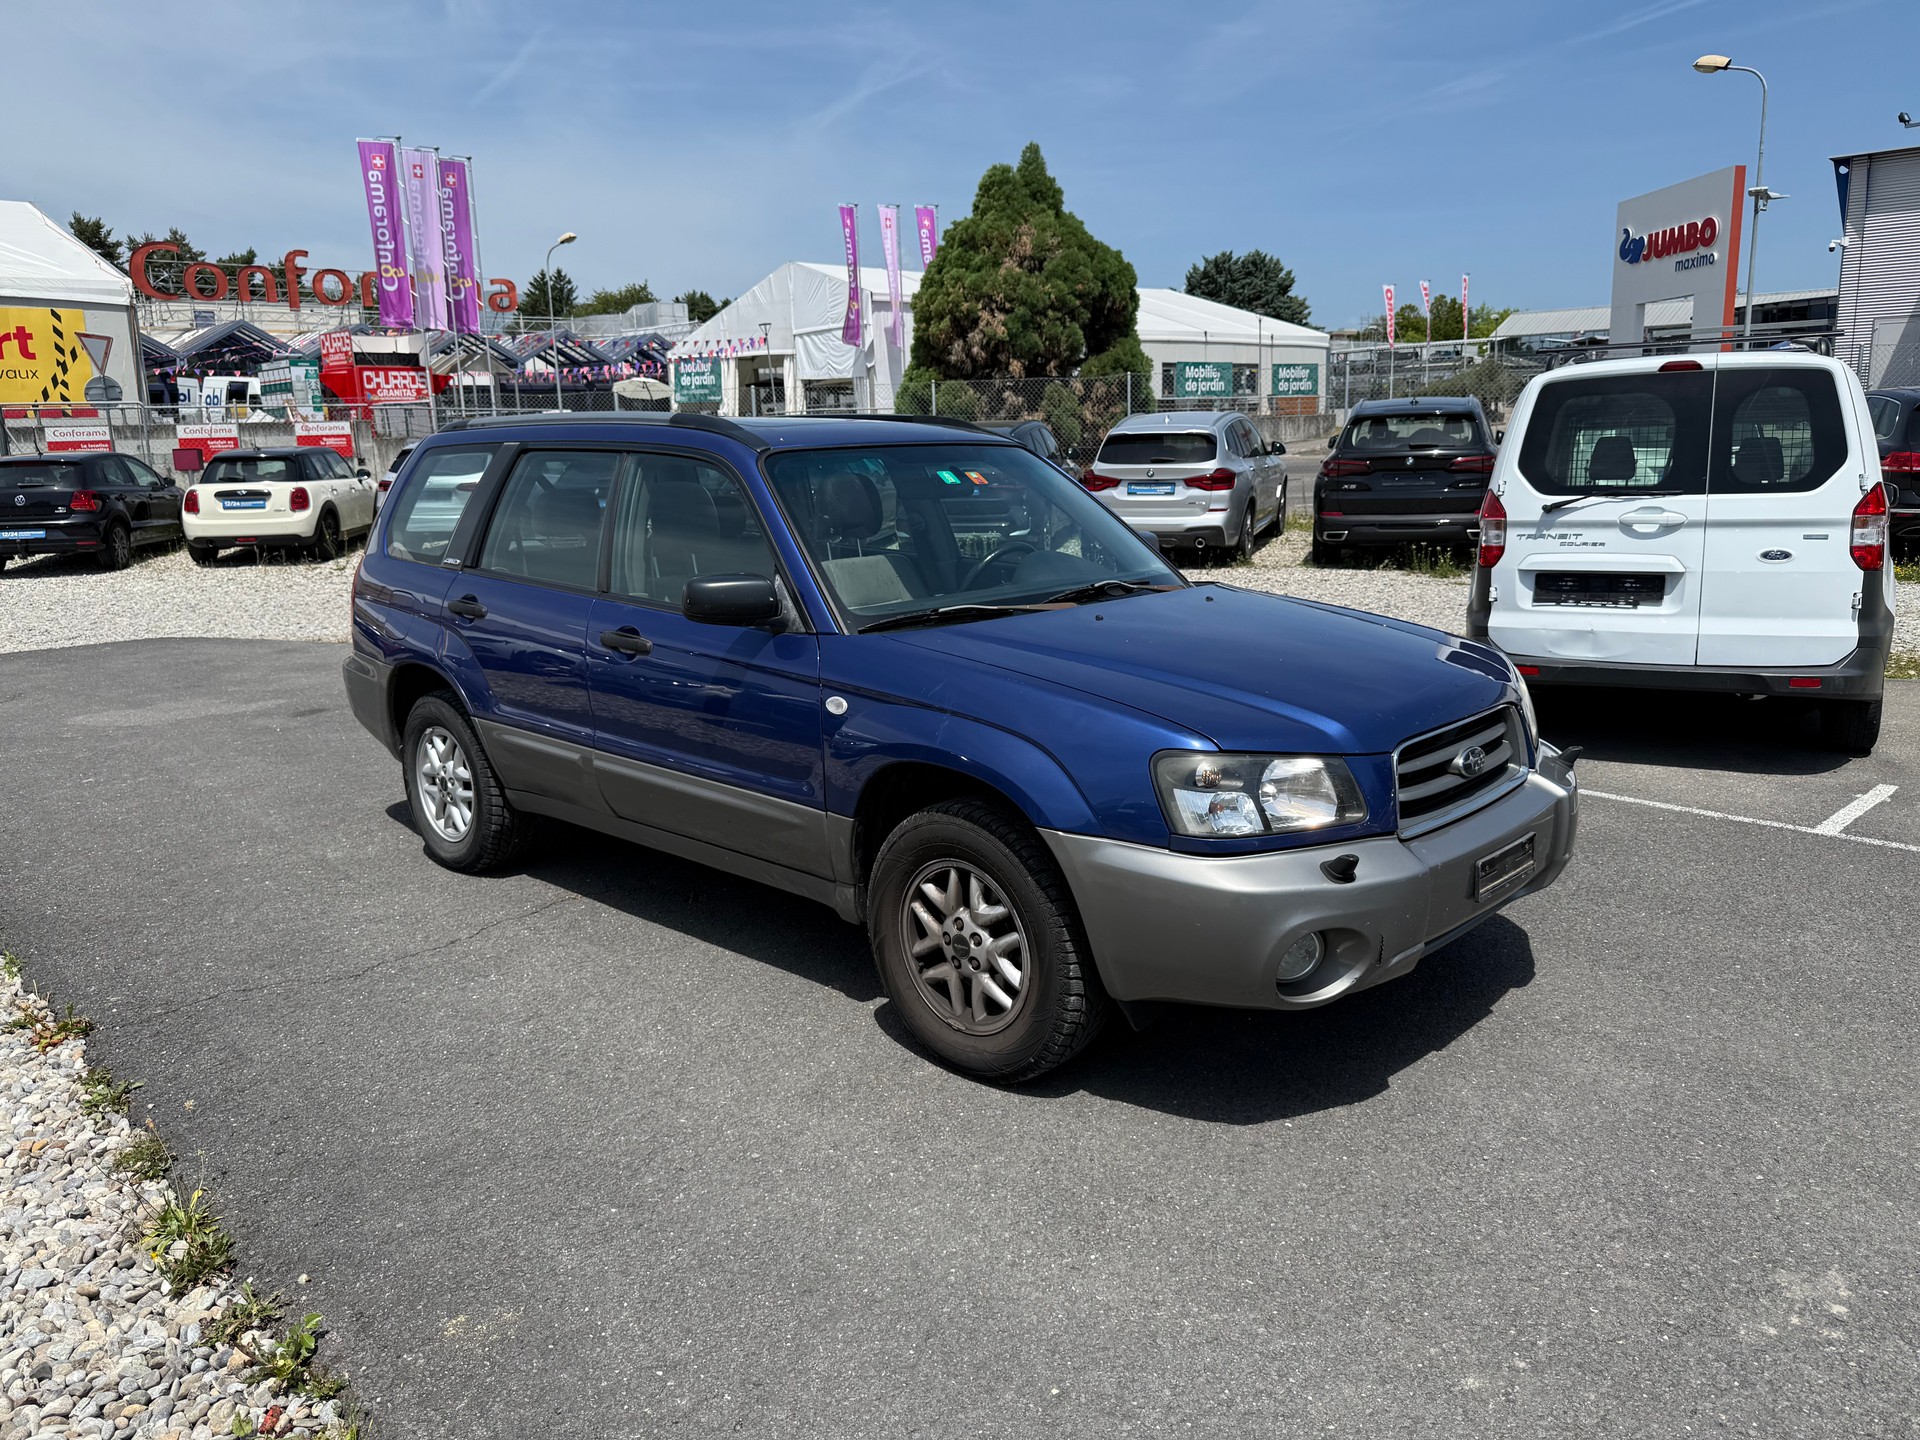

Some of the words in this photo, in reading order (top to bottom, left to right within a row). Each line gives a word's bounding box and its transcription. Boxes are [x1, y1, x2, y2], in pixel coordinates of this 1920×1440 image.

[1641, 216, 1718, 262] JUMBO
[1674, 252, 1716, 272] maximo
[129, 241, 519, 314] Confora
[363, 371, 427, 389] CHURROS
[680, 373, 691, 386] de
[691, 372, 716, 390] jardin
[1278, 366, 1309, 379] Mobilier
[377, 389, 417, 397] GRANITAS
[1185, 379, 1197, 391] de
[1197, 378, 1225, 395] jardin
[1278, 379, 1289, 391] de
[1289, 378, 1312, 395] jardin
[52, 429, 107, 438] Conforama
[1516, 533, 1584, 541] TRANSIT
